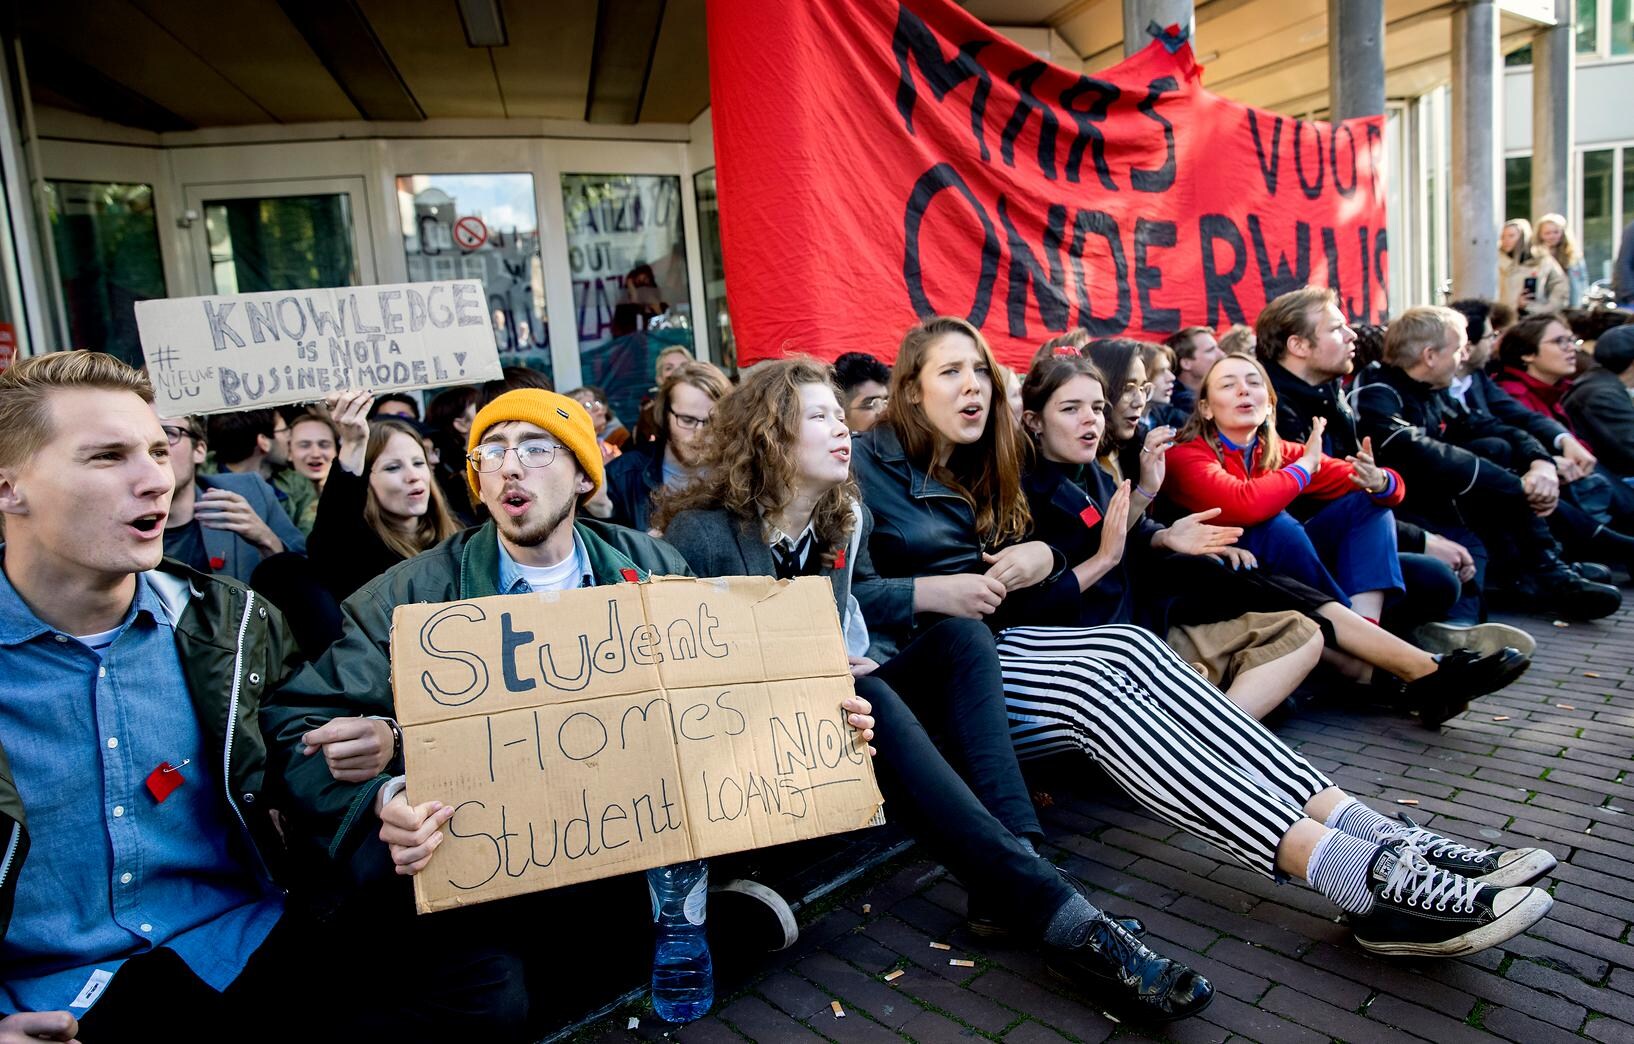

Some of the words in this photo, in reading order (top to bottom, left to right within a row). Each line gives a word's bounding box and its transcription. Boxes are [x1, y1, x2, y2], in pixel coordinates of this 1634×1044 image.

[892, 4, 1180, 193] MARS
[203, 284, 484, 351] KNOWLEDGE
[328, 334, 386, 370] NOT
[388, 340, 402, 355] A
[420, 600, 729, 706] Student
[448, 778, 682, 890] Student
[702, 770, 807, 823] LOANS
